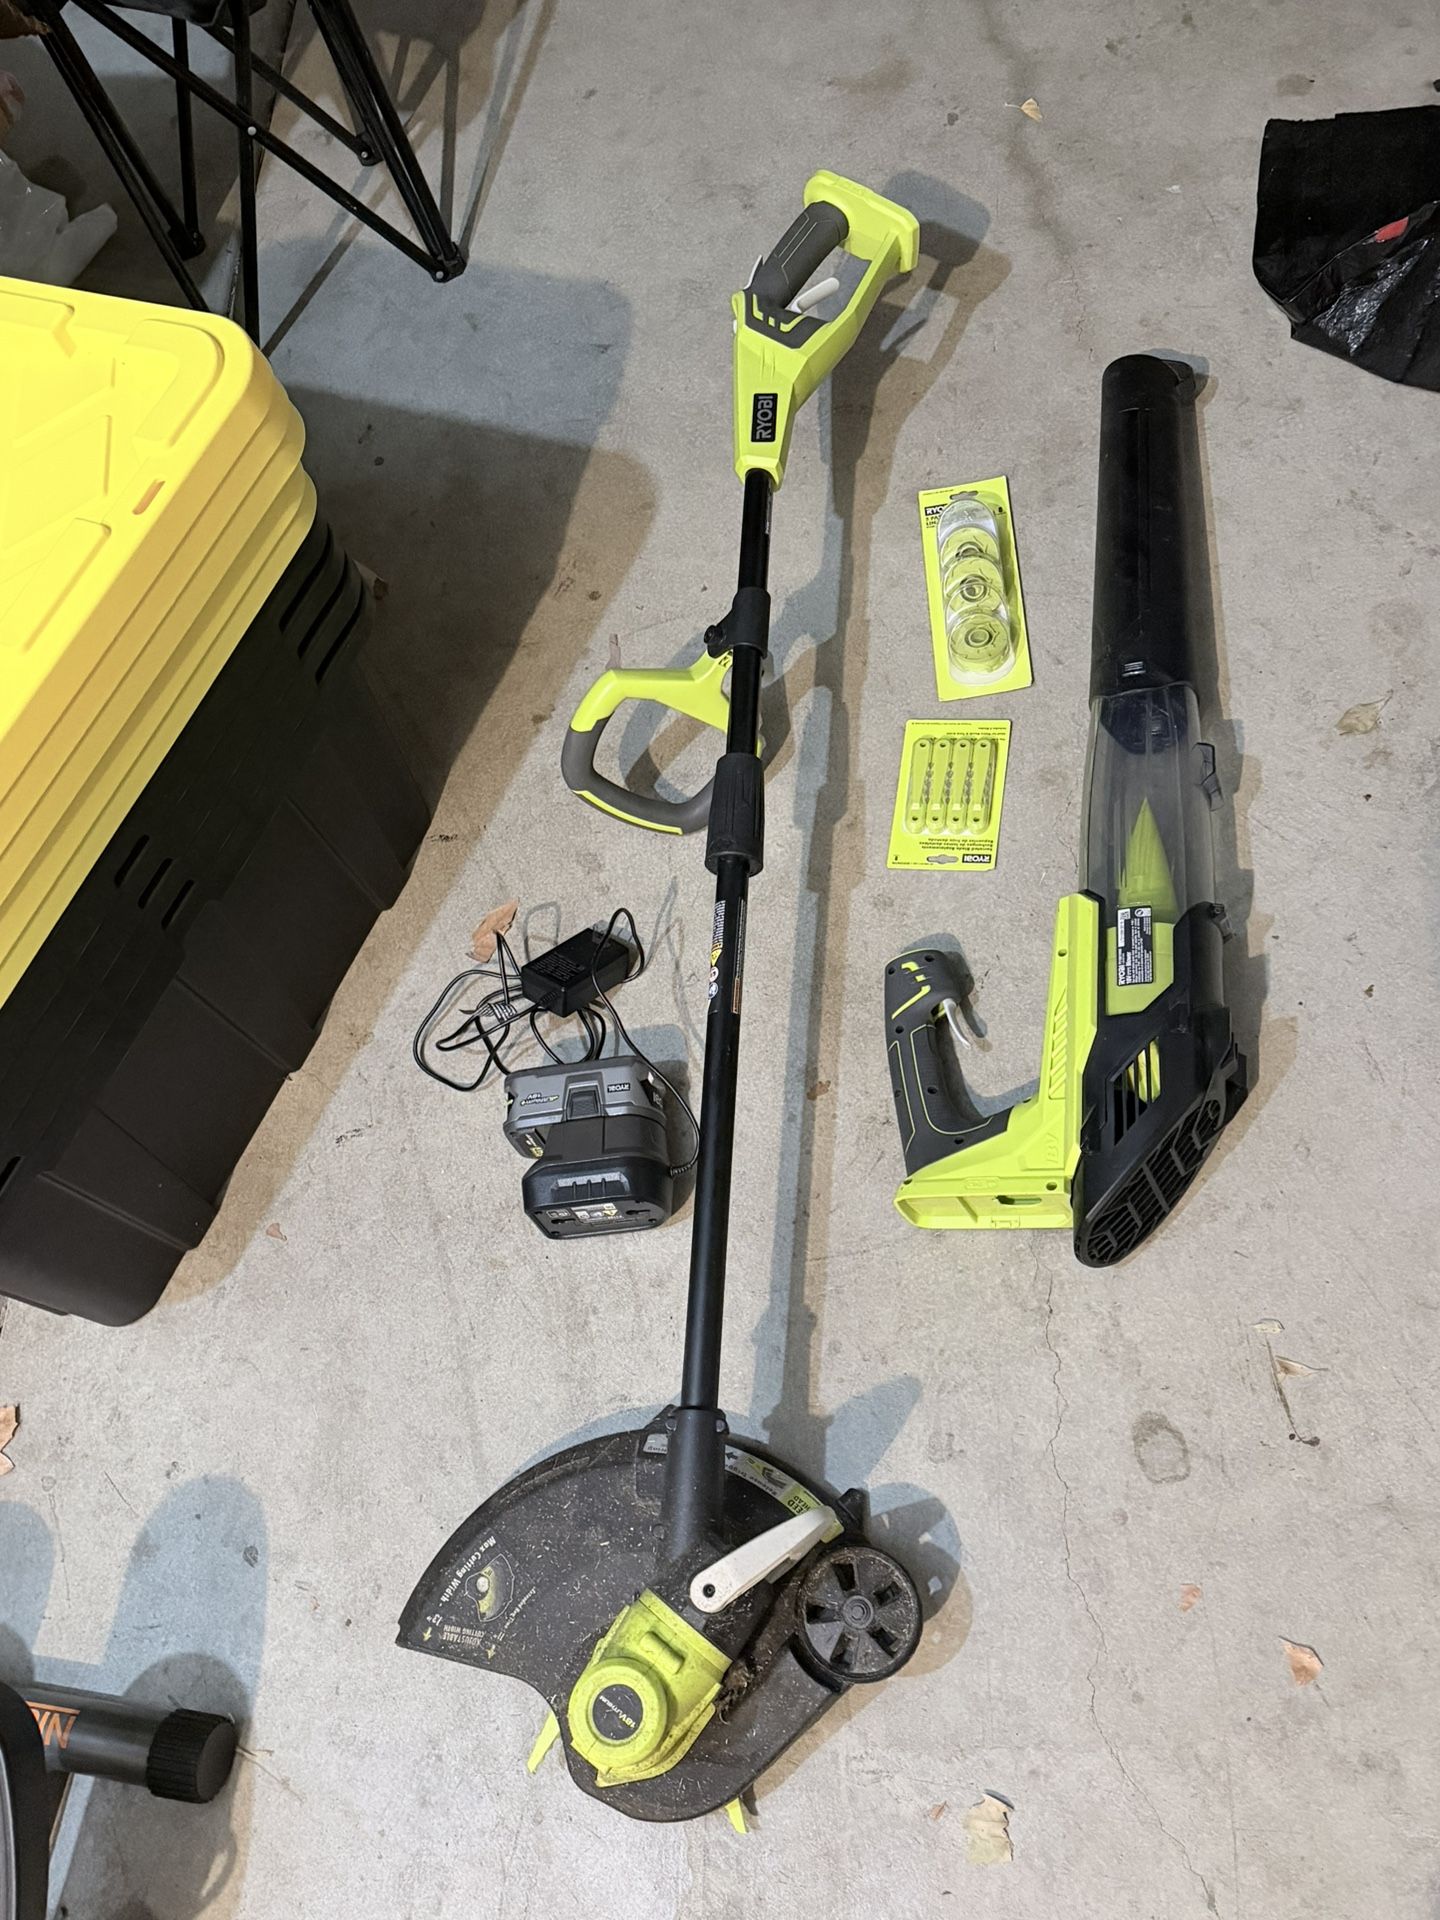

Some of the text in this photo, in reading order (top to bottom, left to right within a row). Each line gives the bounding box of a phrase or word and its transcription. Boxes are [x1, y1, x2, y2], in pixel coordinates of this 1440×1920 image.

[756, 395, 773, 440] RYOBI
[1118, 965, 1126, 985] RYOBI
[608, 1084, 630, 1092] RYOBI
[480, 1535, 496, 1553] Max
[456, 1551, 482, 1579] Cutting
[440, 1577, 461, 1602] Width
[441, 1631, 483, 1647] ADJUSTABLE
[619, 1713, 636, 1728] 18V
